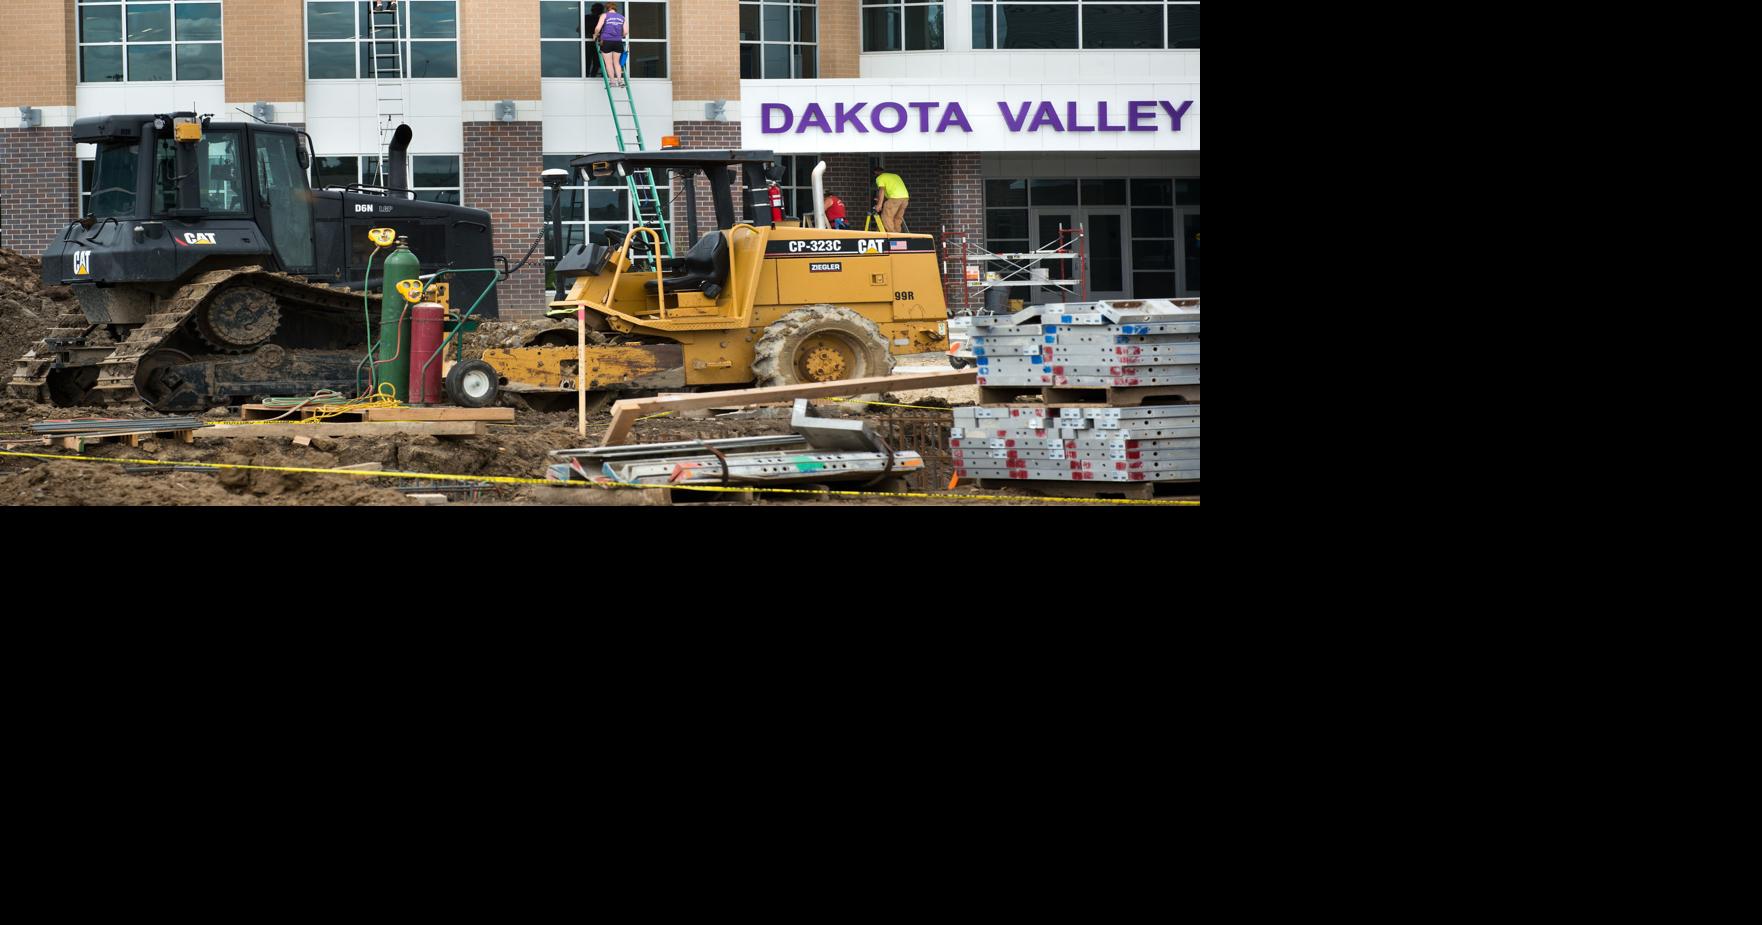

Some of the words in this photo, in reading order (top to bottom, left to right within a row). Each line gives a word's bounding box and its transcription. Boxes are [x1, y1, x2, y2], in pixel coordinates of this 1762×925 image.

[761, 101, 973, 134] DAKOTA
[997, 100, 1194, 132] VALLEY
[355, 204, 373, 213] D6N
[183, 232, 217, 245] CAT
[788, 240, 842, 252] CP-323C
[857, 239, 885, 254] CAT
[73, 250, 91, 275] CAT
[811, 263, 841, 271] ZIEGLER
[894, 291, 915, 301] 99R
